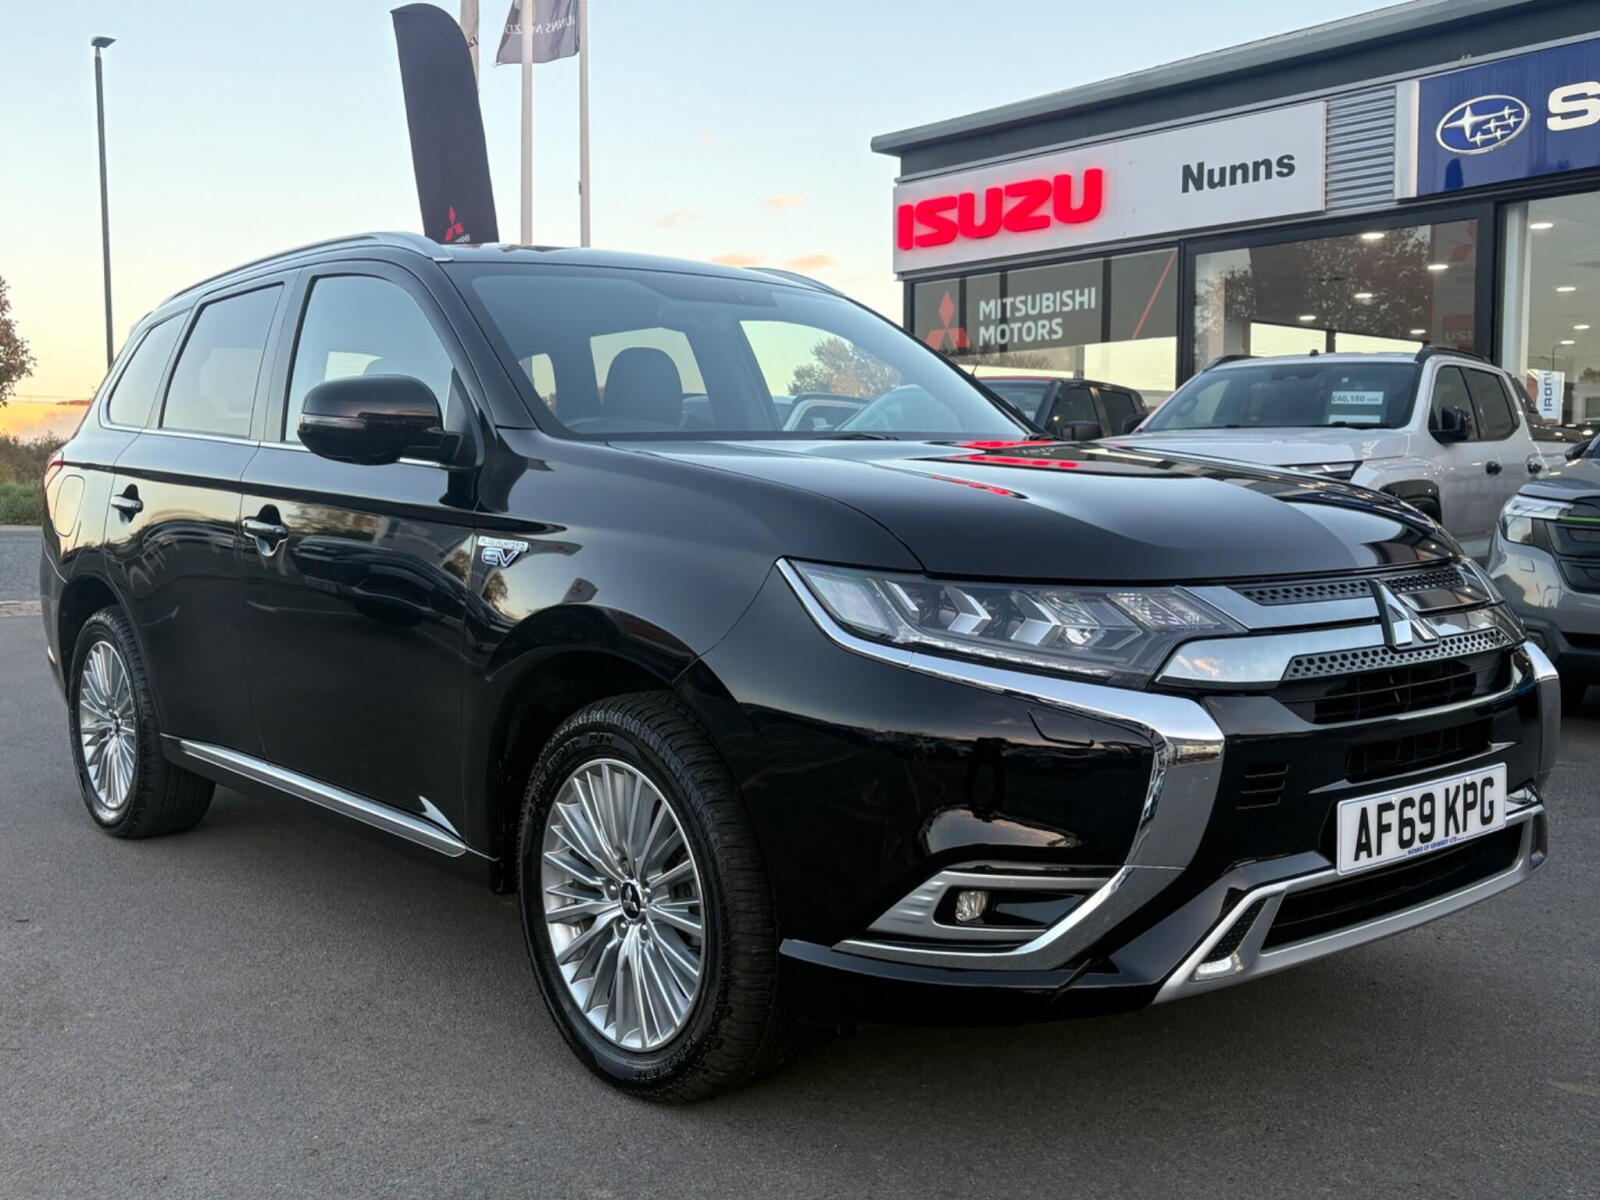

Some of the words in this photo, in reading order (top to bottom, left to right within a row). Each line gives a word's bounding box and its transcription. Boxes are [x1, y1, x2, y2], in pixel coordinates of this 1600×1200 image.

[1181, 153, 1296, 193] Nunns
[897, 168, 1104, 251] ISUZU
[979, 286, 1096, 321] MITSUBISHI
[978, 319, 1063, 347] MOTORS
[482, 547, 520, 567] EV
[1353, 792, 1436, 862] AF69
[1444, 776, 1495, 838] KPG
